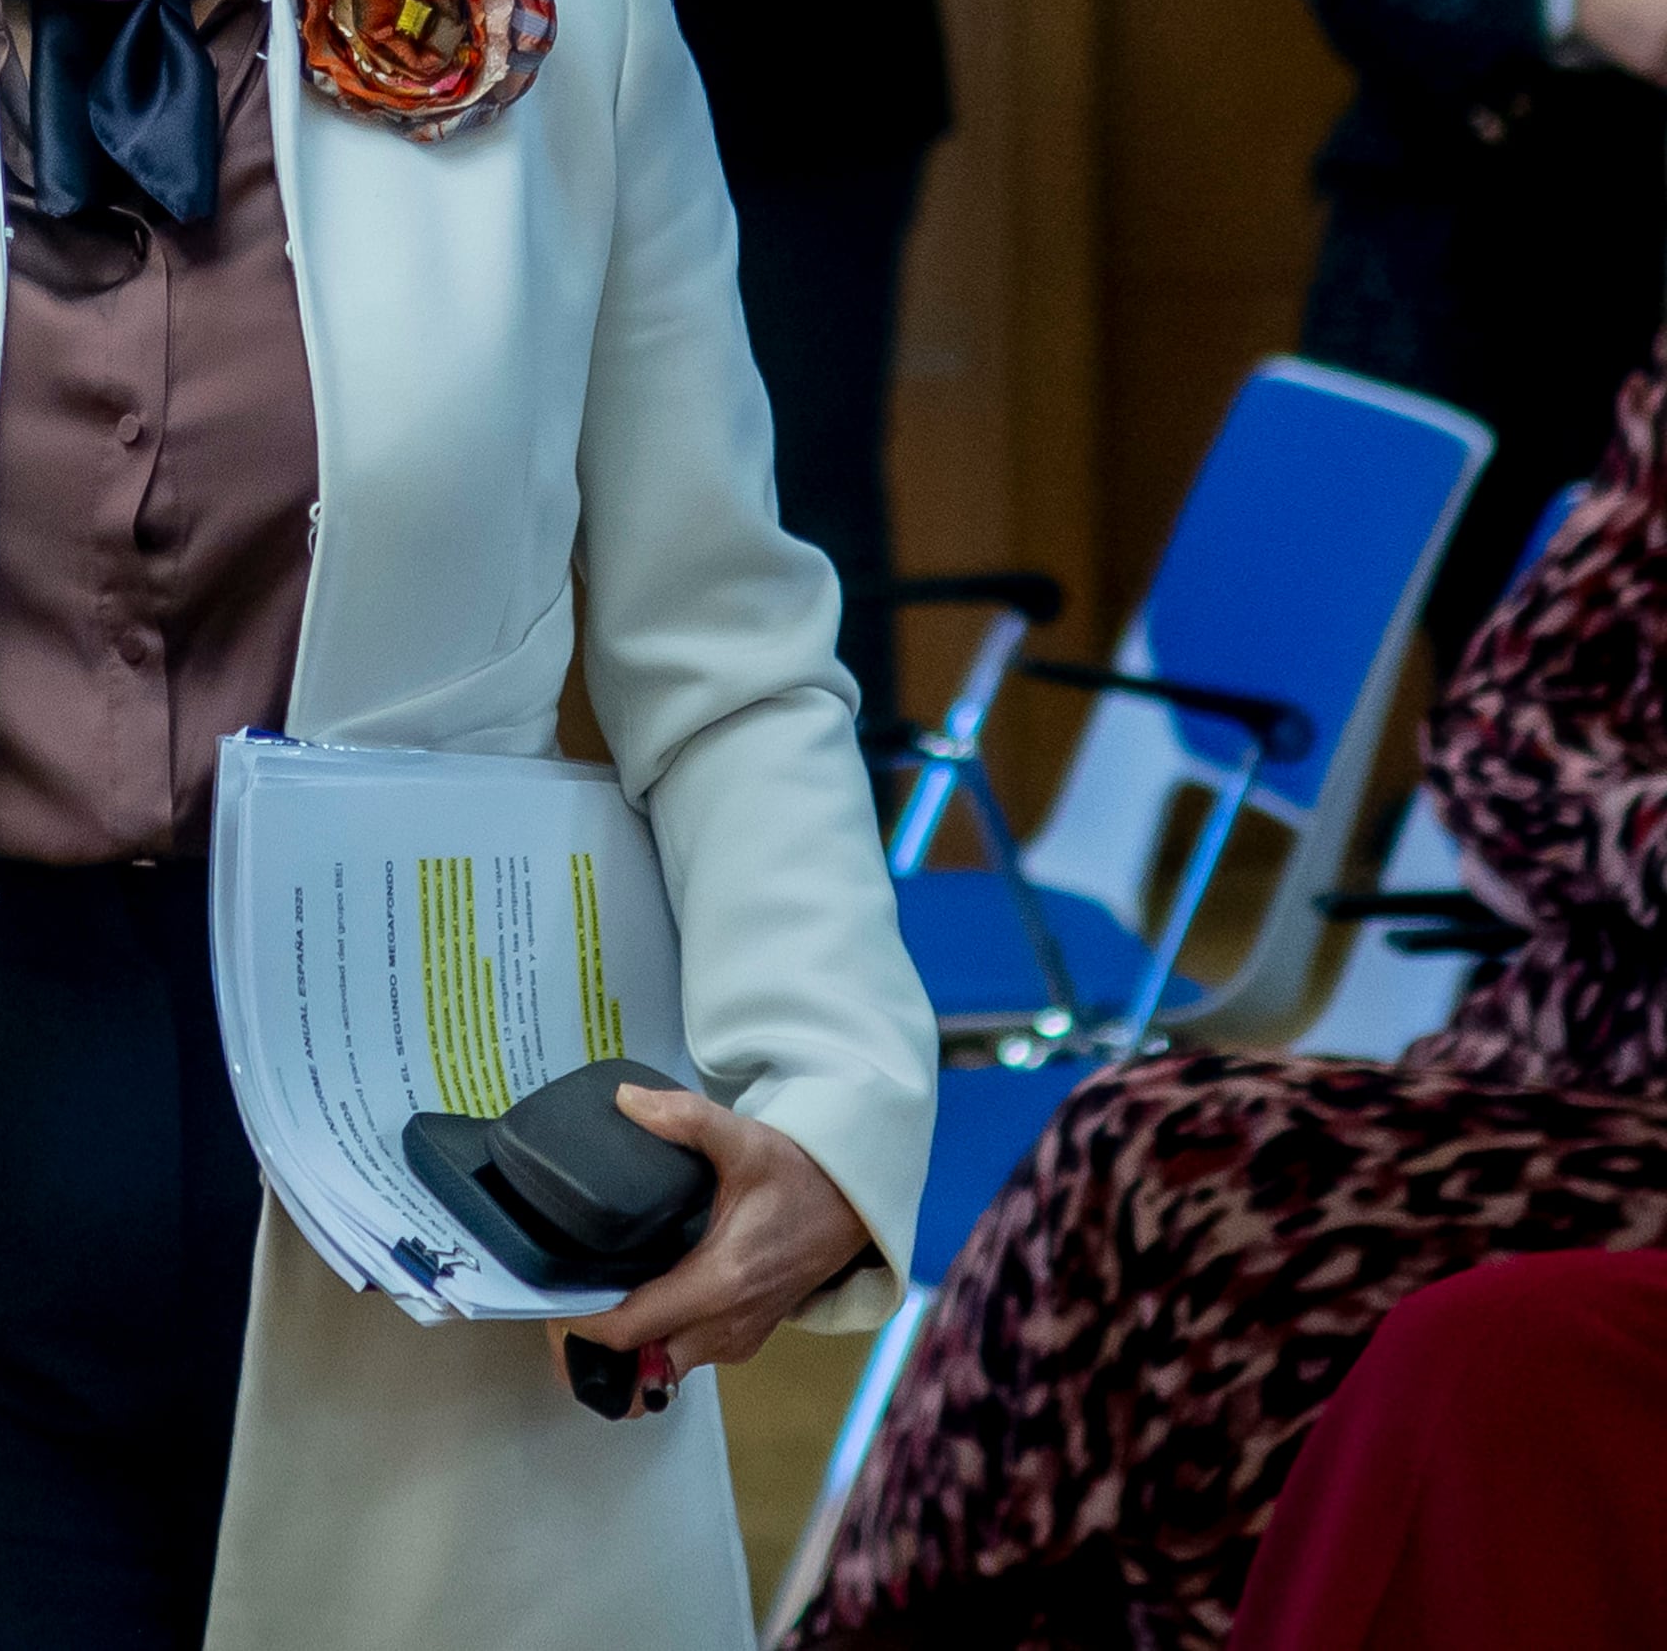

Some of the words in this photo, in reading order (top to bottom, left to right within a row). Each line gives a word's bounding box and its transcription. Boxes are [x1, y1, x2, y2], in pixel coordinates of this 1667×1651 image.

[335, 862, 343, 888] BEI
[450, 858, 459, 921] mercado
[509, 857, 519, 925] empresas
[295, 887, 303, 923] 2025
[336, 893, 346, 934] grupo
[385, 860, 396, 968] MEGAFONDO
[421, 899, 431, 963] inversión
[437, 883, 446, 939] objetivo
[525, 881, 535, 947] quedarse
[294, 928, 307, 998] ESPAÑA
[337, 939, 345, 961] del
[337, 965, 350, 1030] actividad
[389, 974, 405, 1056] SEGUNDO
[299, 1003, 314, 1061] ANUAL
[345, 1035, 352, 1047] la
[503, 1026, 511, 1042] 13
[348, 1052, 361, 1085] para
[401, 1062, 410, 1082] EL
[309, 1064, 339, 1136] INFORME
[407, 1090, 418, 1111] EN
